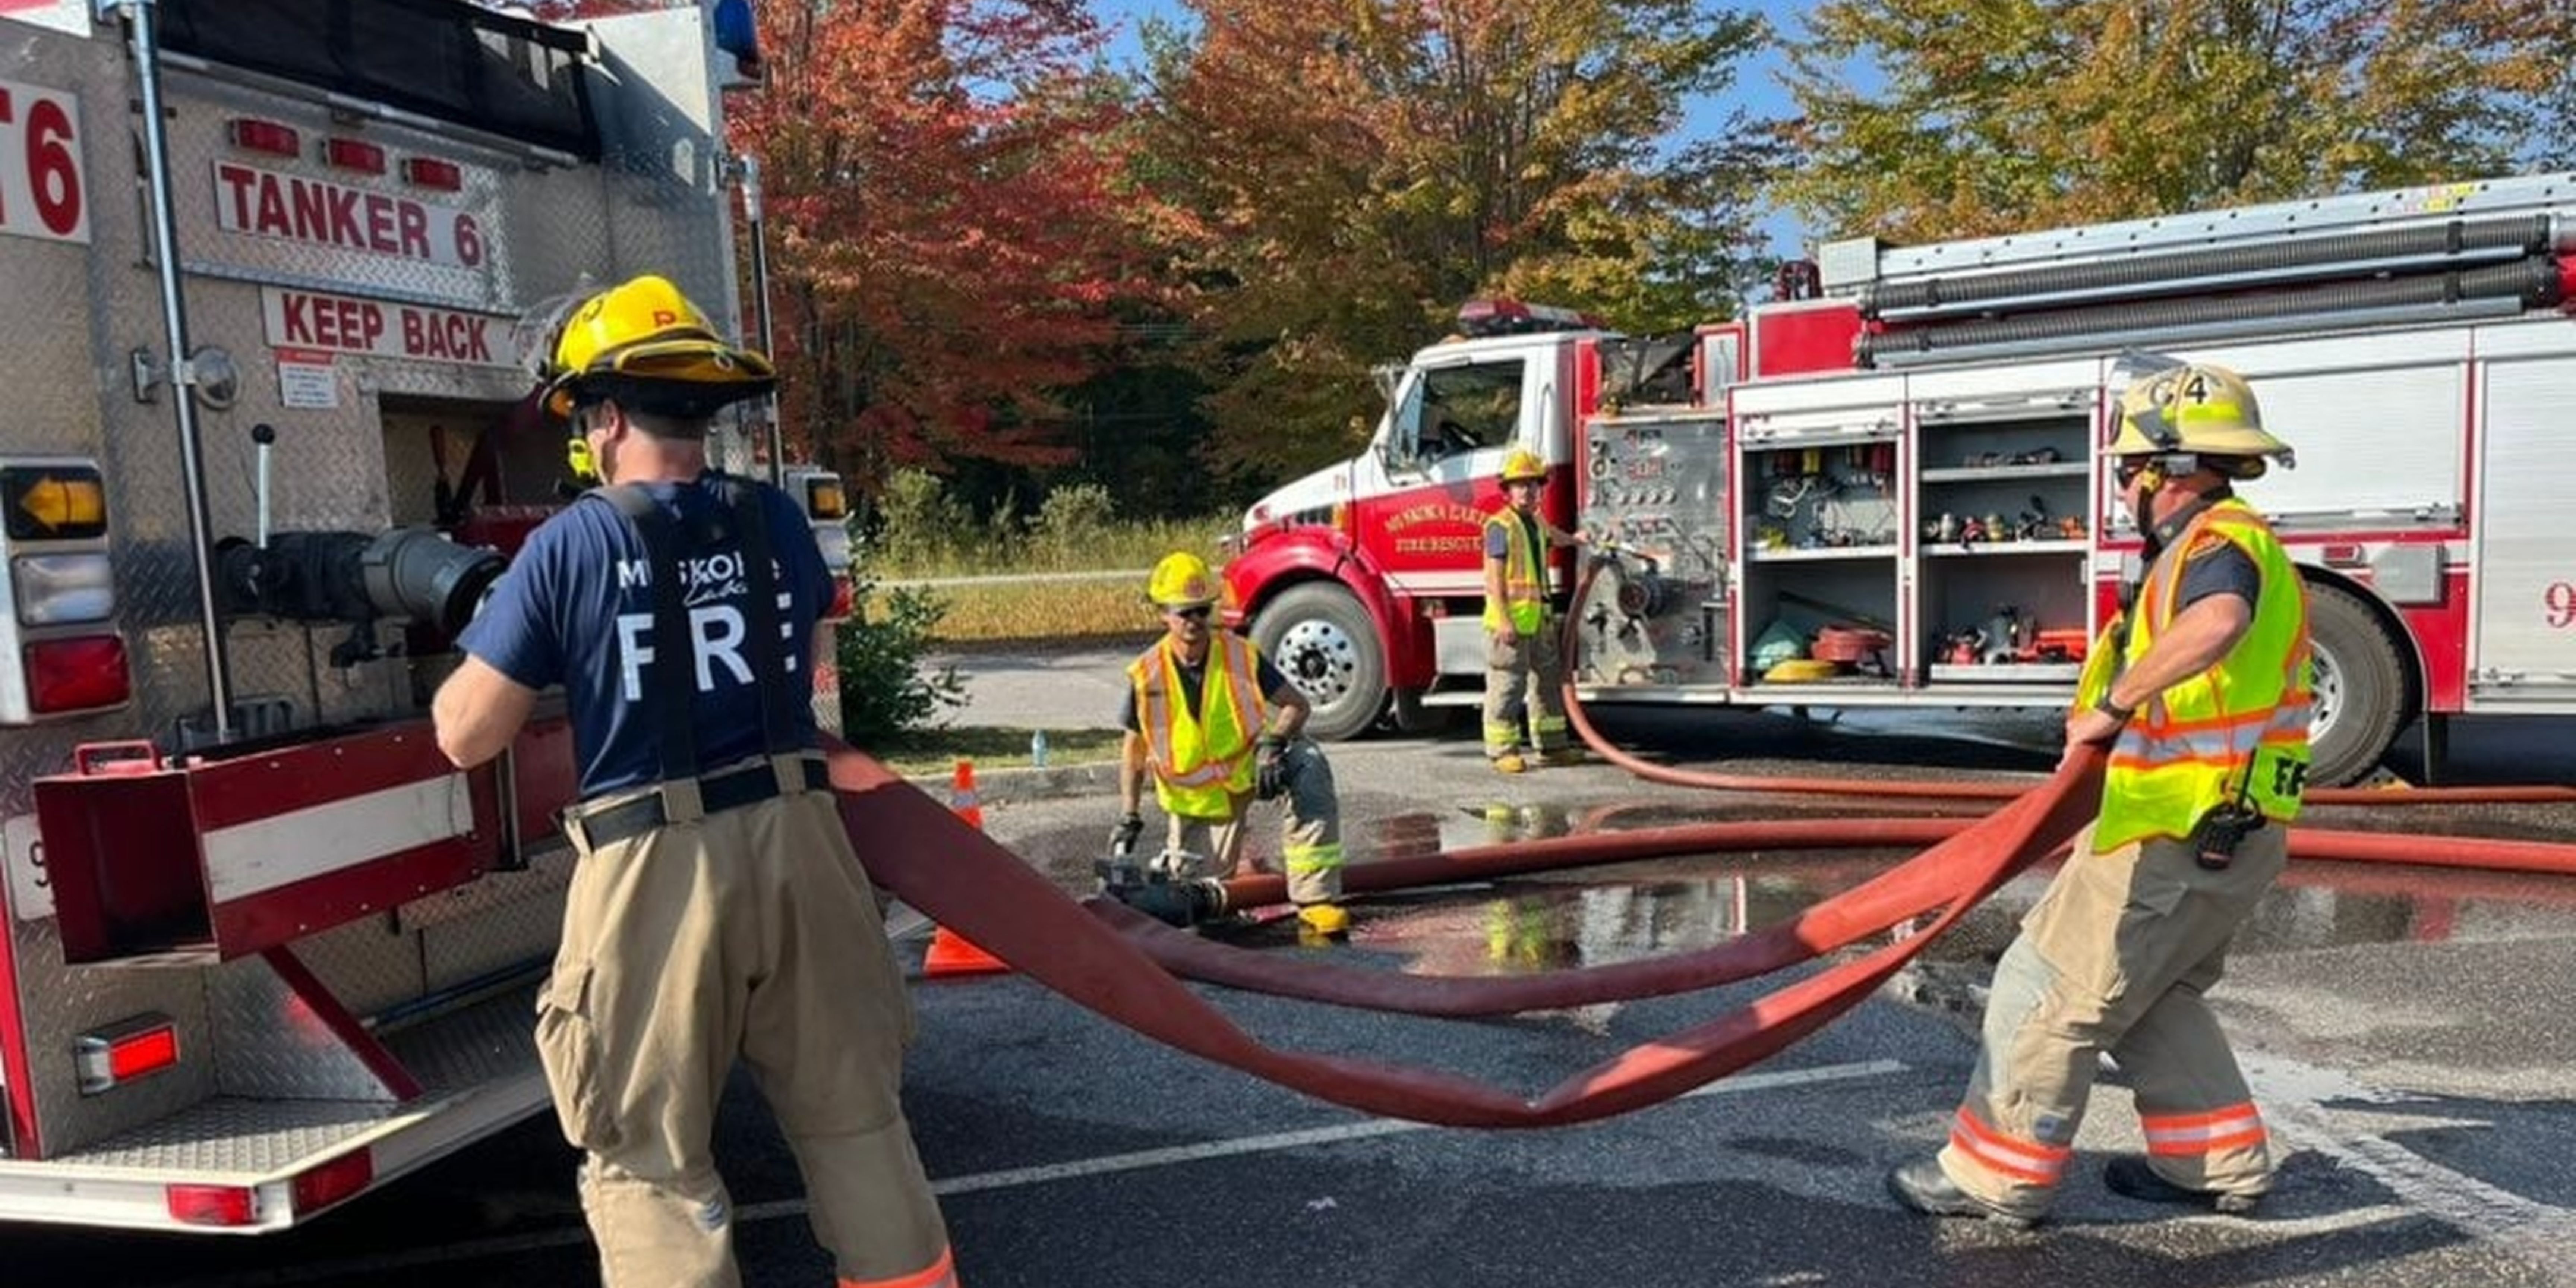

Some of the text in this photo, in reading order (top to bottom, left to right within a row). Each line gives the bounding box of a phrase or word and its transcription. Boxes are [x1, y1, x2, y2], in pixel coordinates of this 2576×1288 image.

[220, 165, 480, 267] TANKER 6
[282, 293, 383, 350] KEEP
[401, 309, 491, 362] BACK
[2184, 376, 2207, 405] 4
